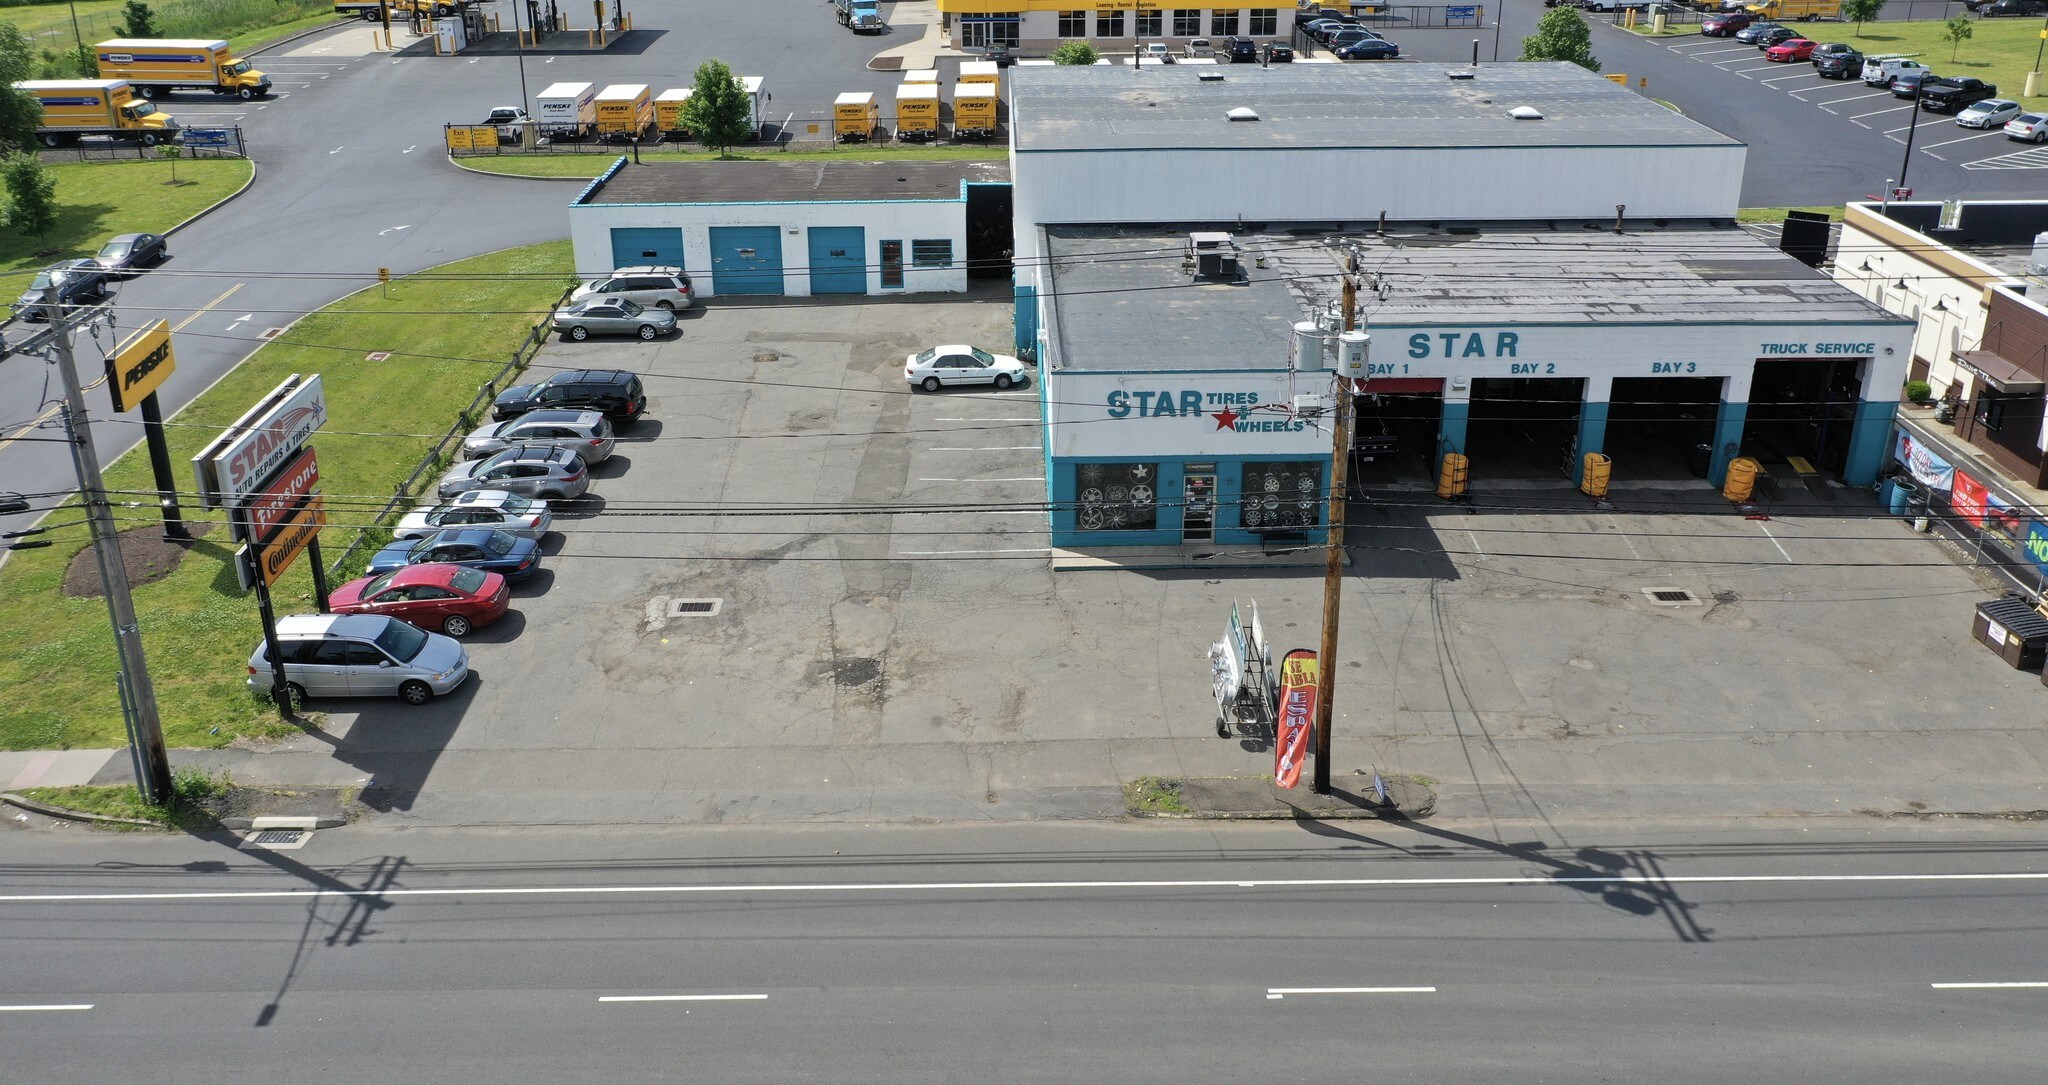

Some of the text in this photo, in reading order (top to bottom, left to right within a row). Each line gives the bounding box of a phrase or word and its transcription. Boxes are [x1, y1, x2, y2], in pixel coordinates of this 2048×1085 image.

[1408, 332, 1518, 358] STAR
[1761, 343, 1875, 354] TRUCK SERVICE
[125, 338, 169, 391] PENSKE
[1367, 363, 1395, 374] BAY
[1403, 364, 1409, 374] 1
[1511, 363, 1555, 374] BAY 2
[1652, 362, 1696, 373] BAY 3
[1107, 390, 1203, 418] STAR
[1206, 392, 1259, 405] TIRES
[1235, 420, 1304, 433] WHEELS
[230, 418, 287, 485] STAR
[235, 422, 310, 498] AUTO REPAIRS & TIRES
[257, 460, 317, 531] Firestone
[268, 509, 318, 576] Continental
[1289, 660, 1302, 674] SE
